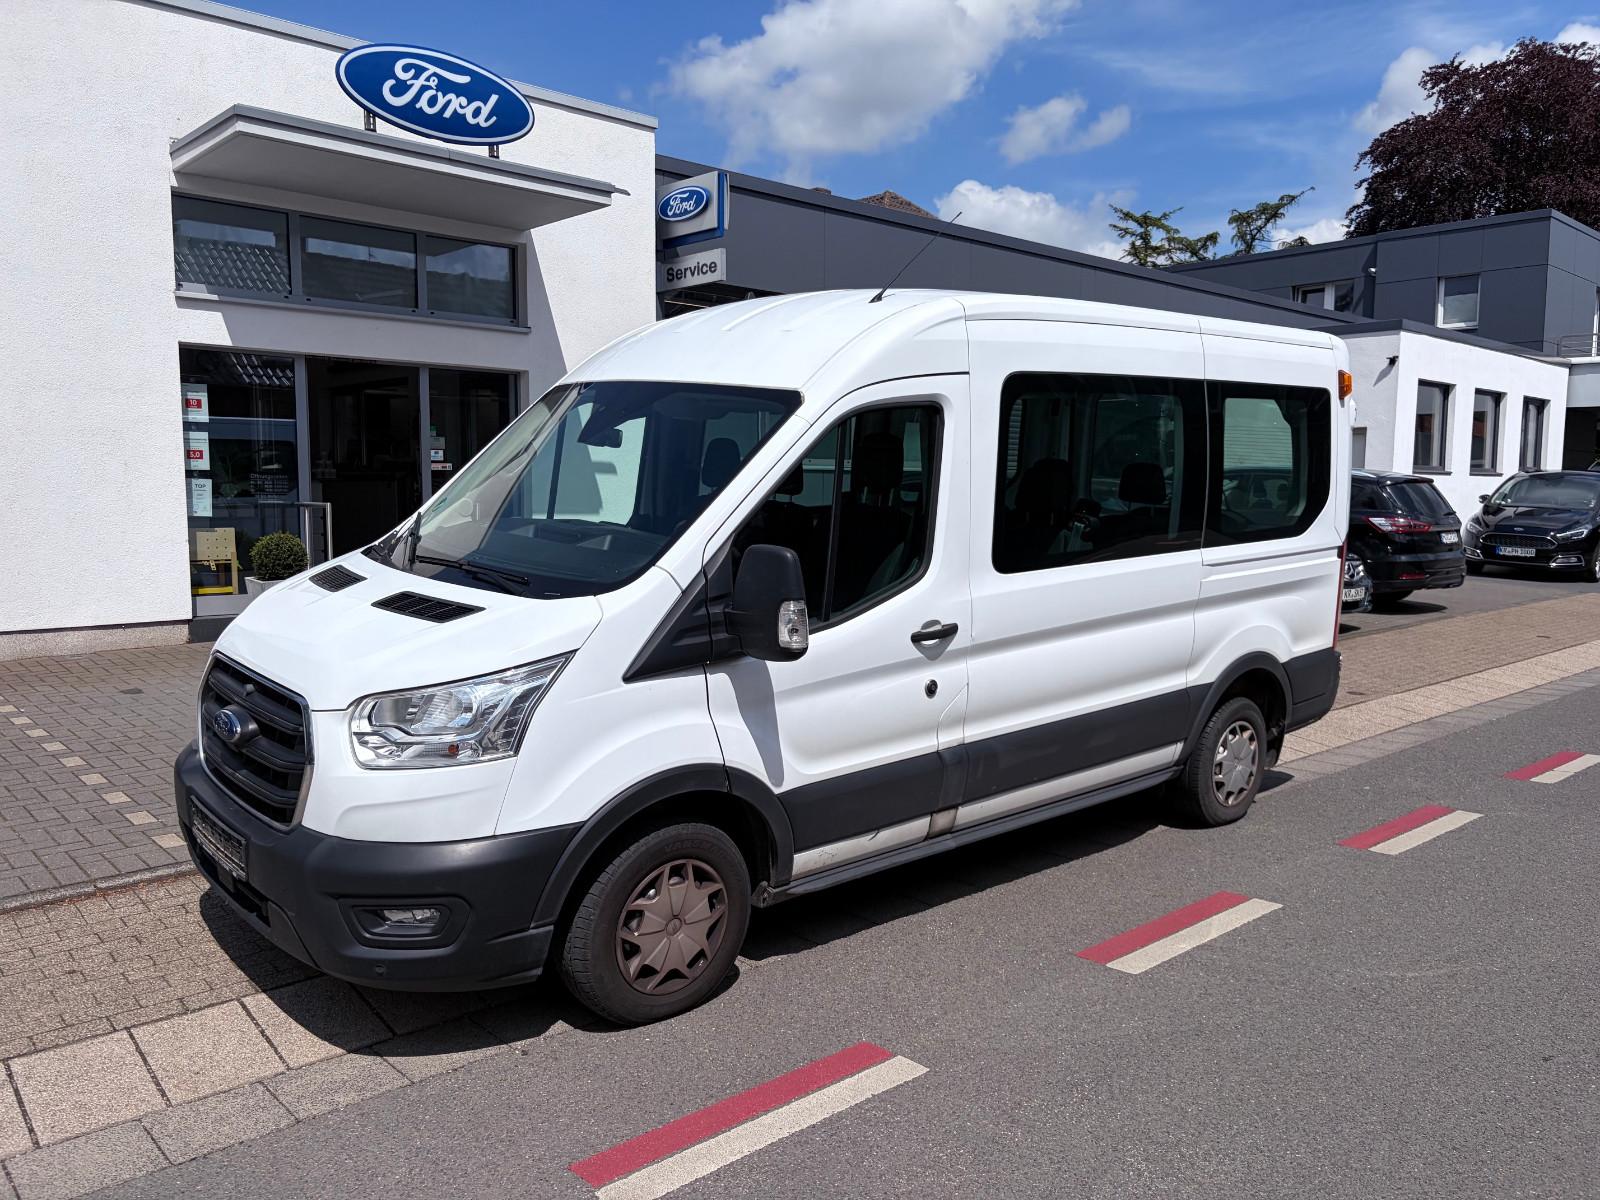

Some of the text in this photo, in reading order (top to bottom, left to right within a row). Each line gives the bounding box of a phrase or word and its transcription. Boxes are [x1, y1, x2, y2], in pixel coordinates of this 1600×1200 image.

[382, 58, 499, 128] Ford
[667, 192, 697, 217] Ford
[666, 261, 718, 282] Service
